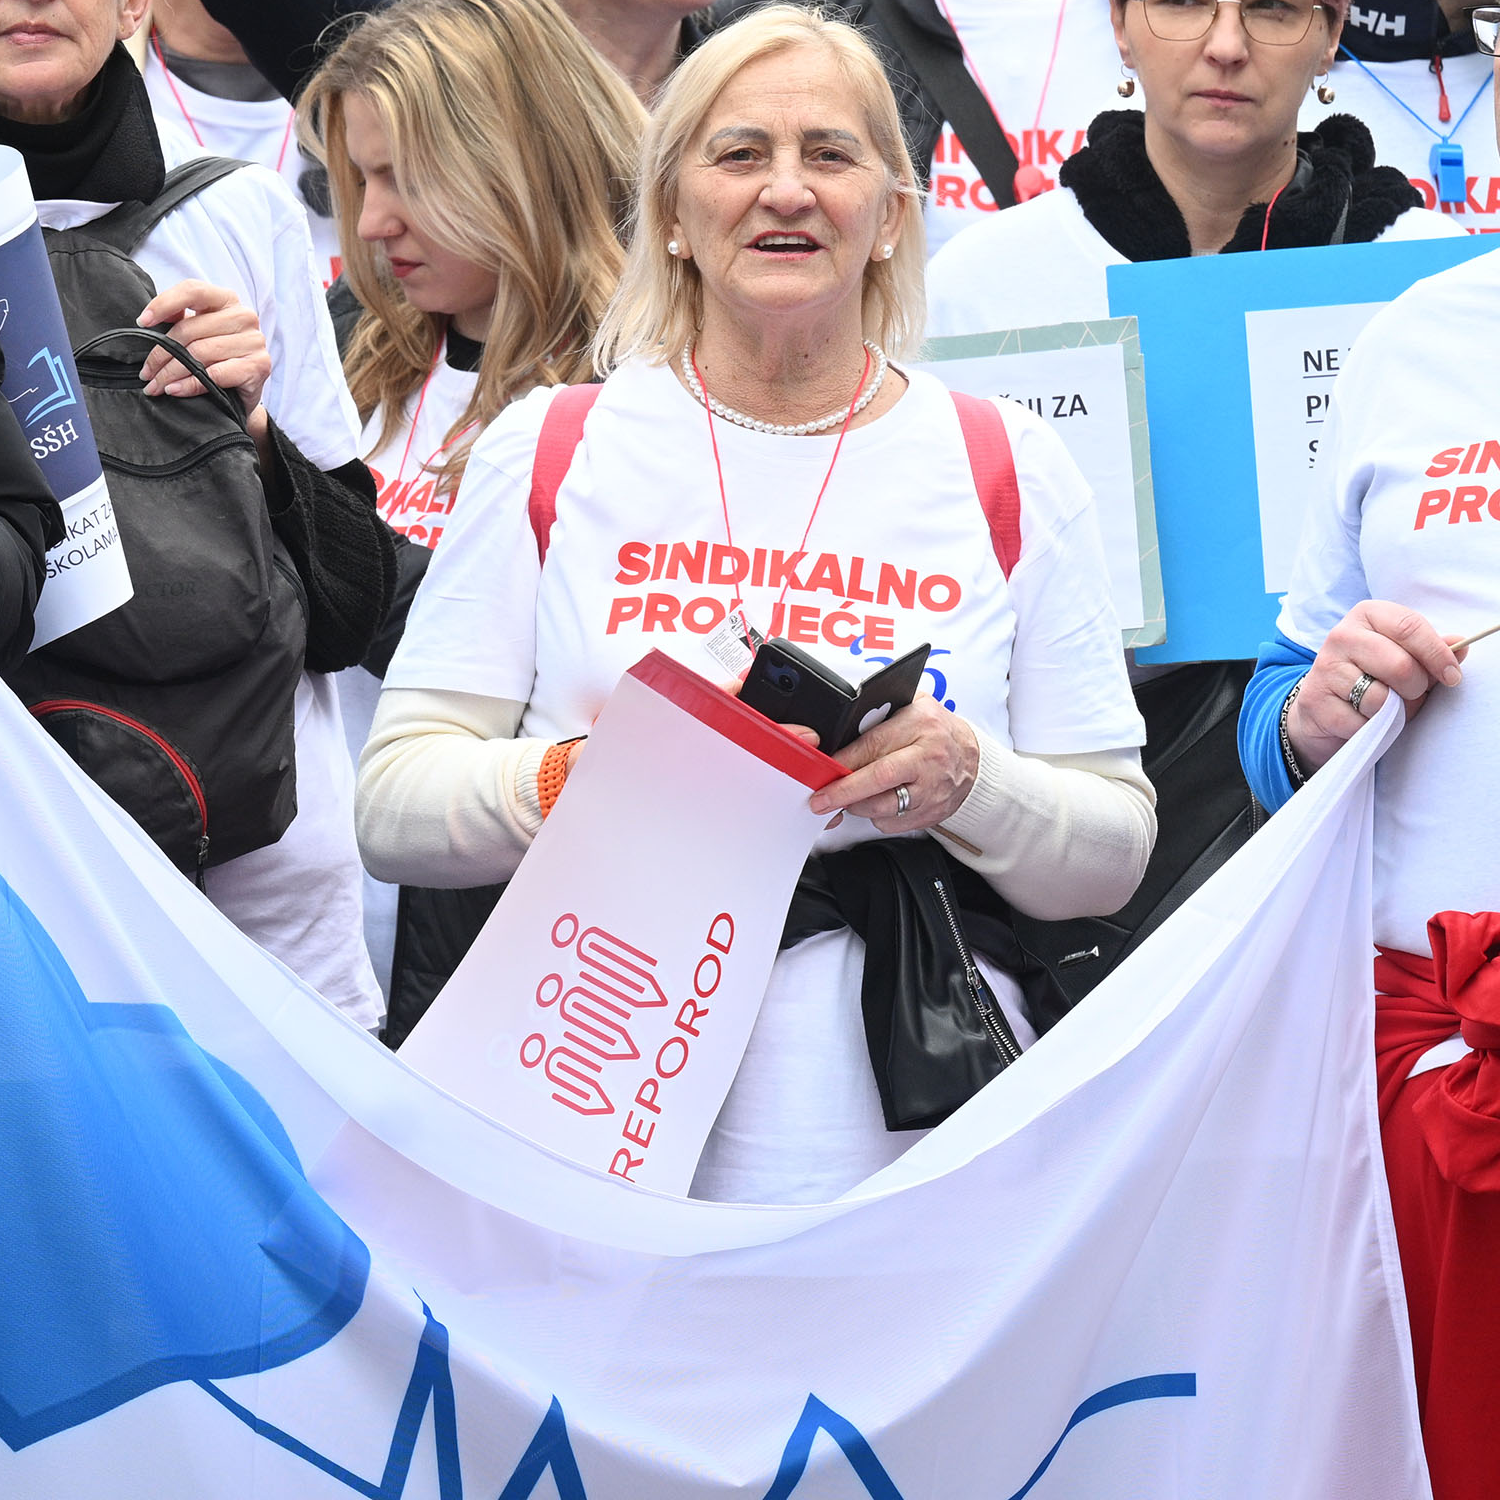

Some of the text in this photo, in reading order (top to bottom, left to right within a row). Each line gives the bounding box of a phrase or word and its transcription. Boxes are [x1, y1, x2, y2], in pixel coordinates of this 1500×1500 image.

[1303, 348, 1341, 373] NE
[1052, 393, 1089, 419] ZA
[30, 418, 80, 460] SŠH
[615, 540, 962, 612] SINDIKALNO
[605, 593, 895, 650] PROJEĆE
[608, 910, 740, 1184] REPOROD
